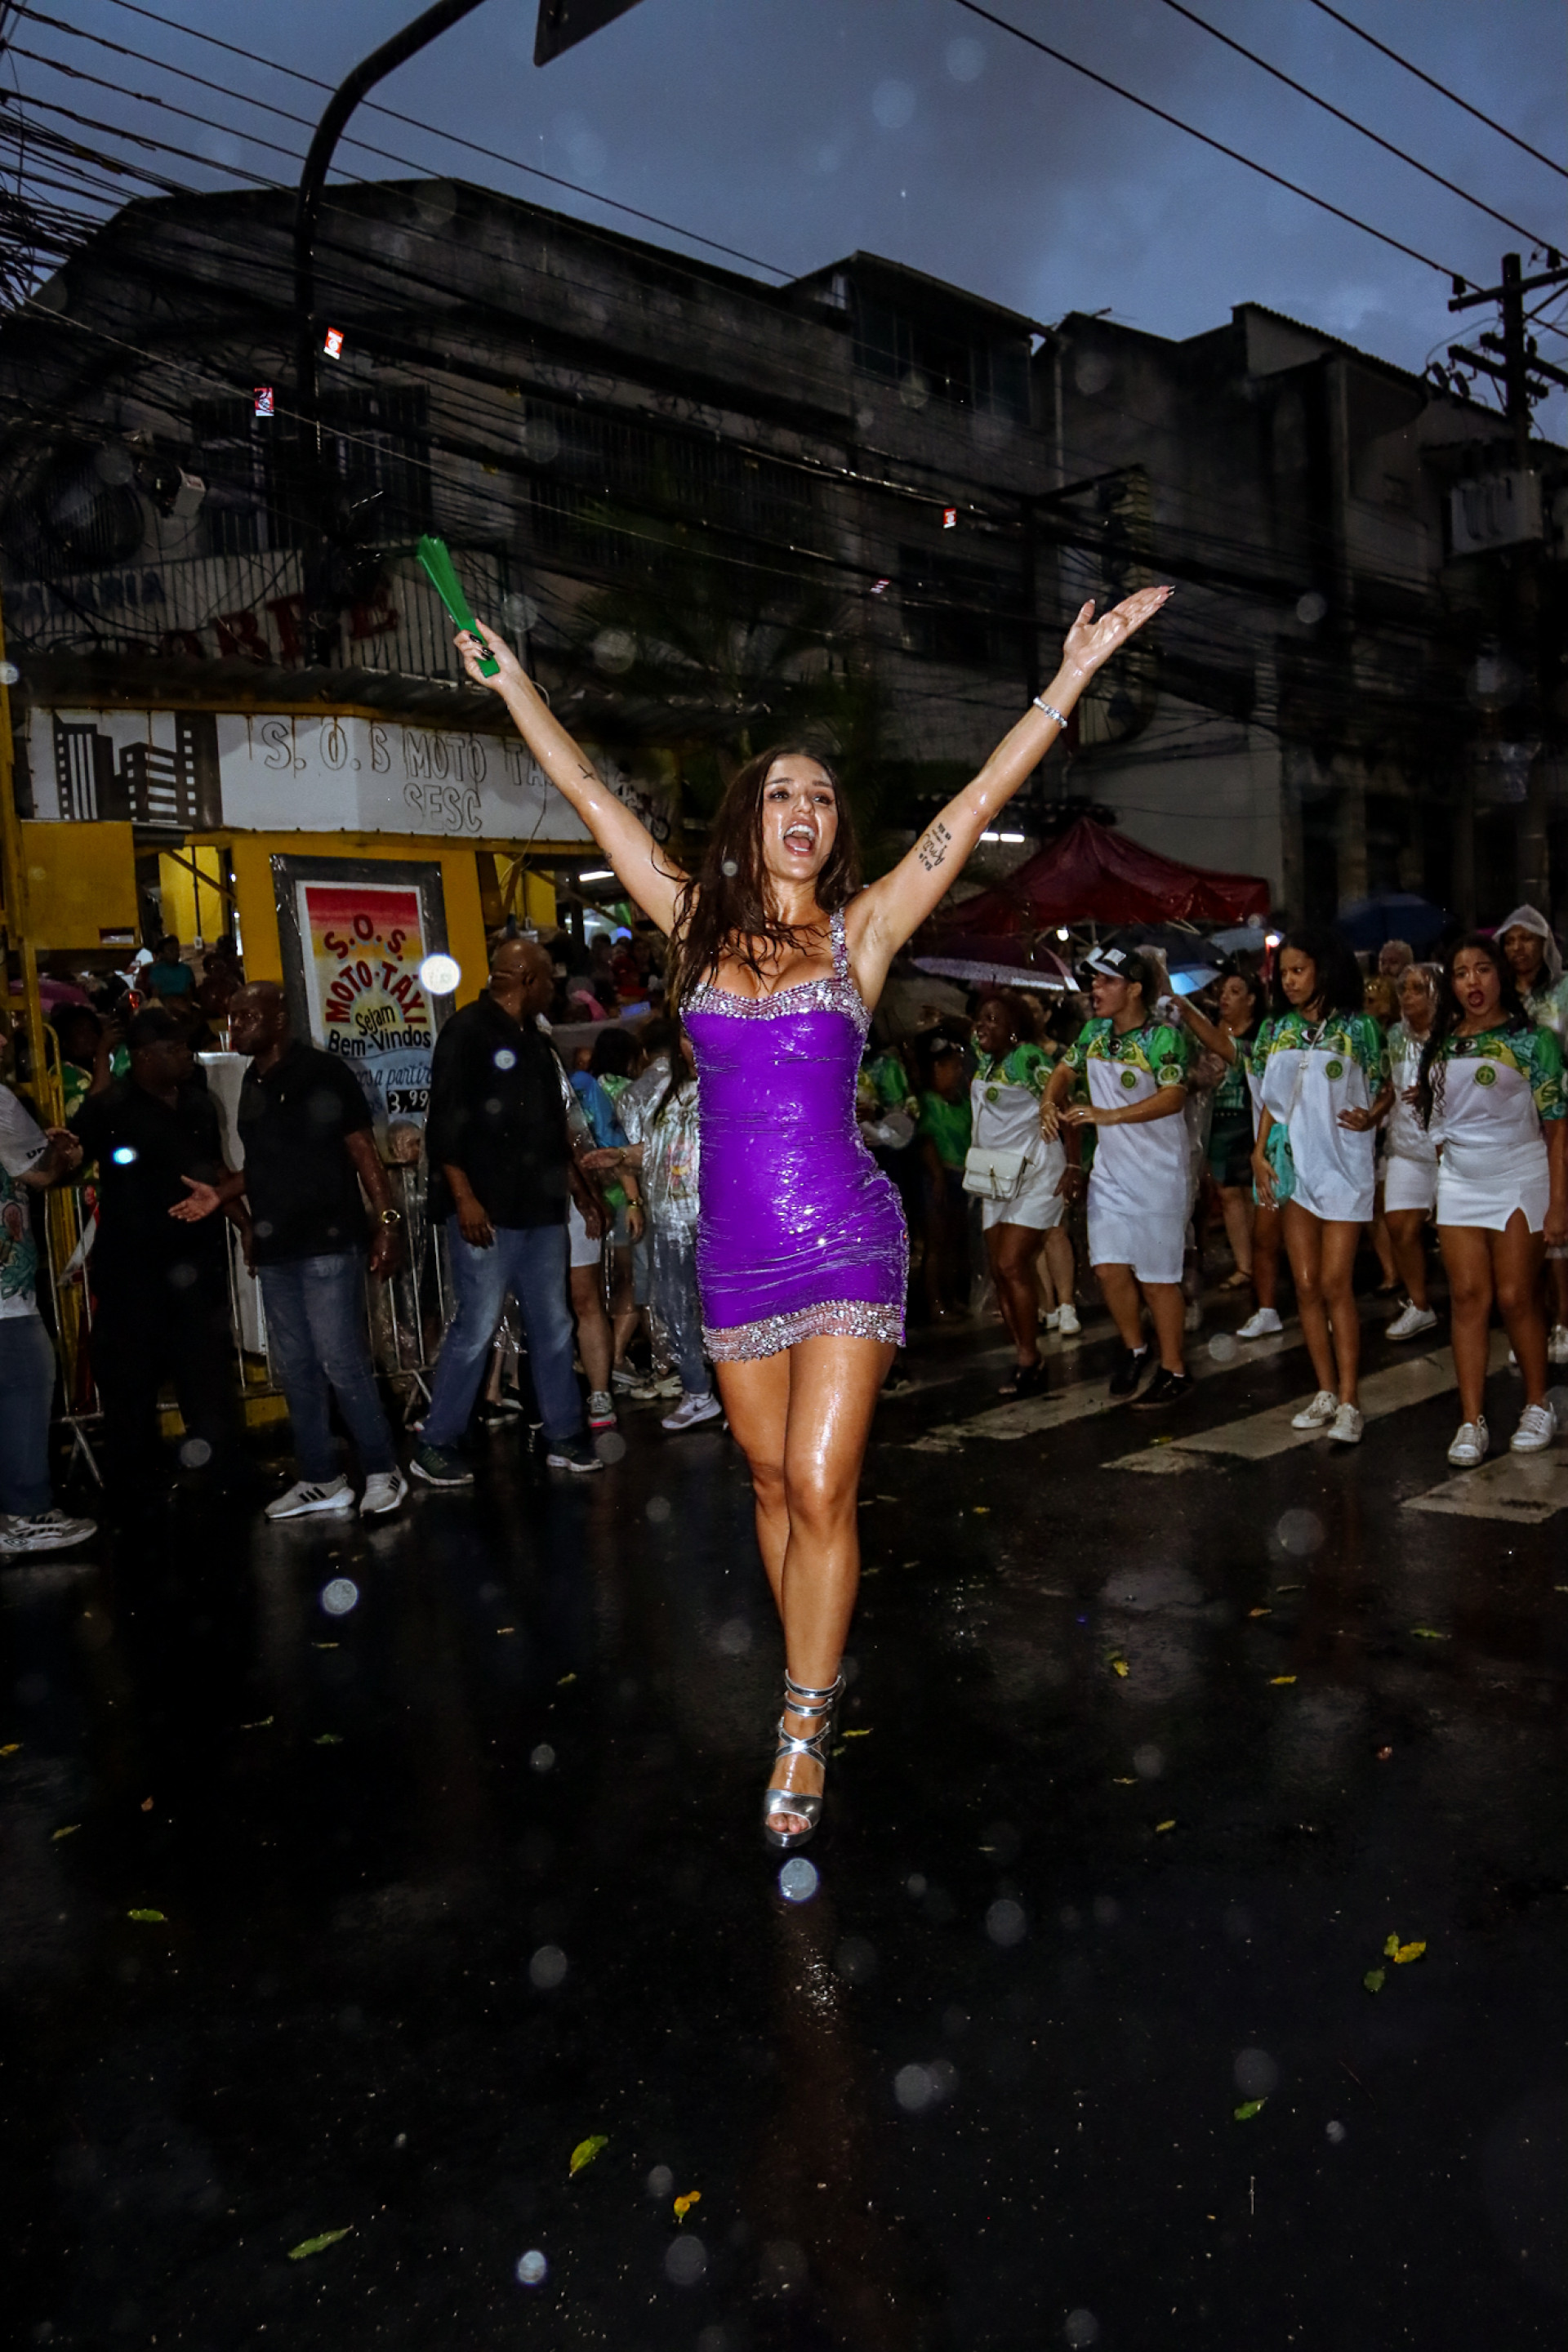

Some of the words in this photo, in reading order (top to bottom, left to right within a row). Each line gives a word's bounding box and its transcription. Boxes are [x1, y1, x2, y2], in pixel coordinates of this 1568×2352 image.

[405, 731, 487, 783] MOTO
[403, 782, 483, 833] SESC
[355, 1004, 396, 1036] Sejam
[327, 1025, 432, 1057] Bem-Vindos
[388, 1089, 430, 1114] 3,99
